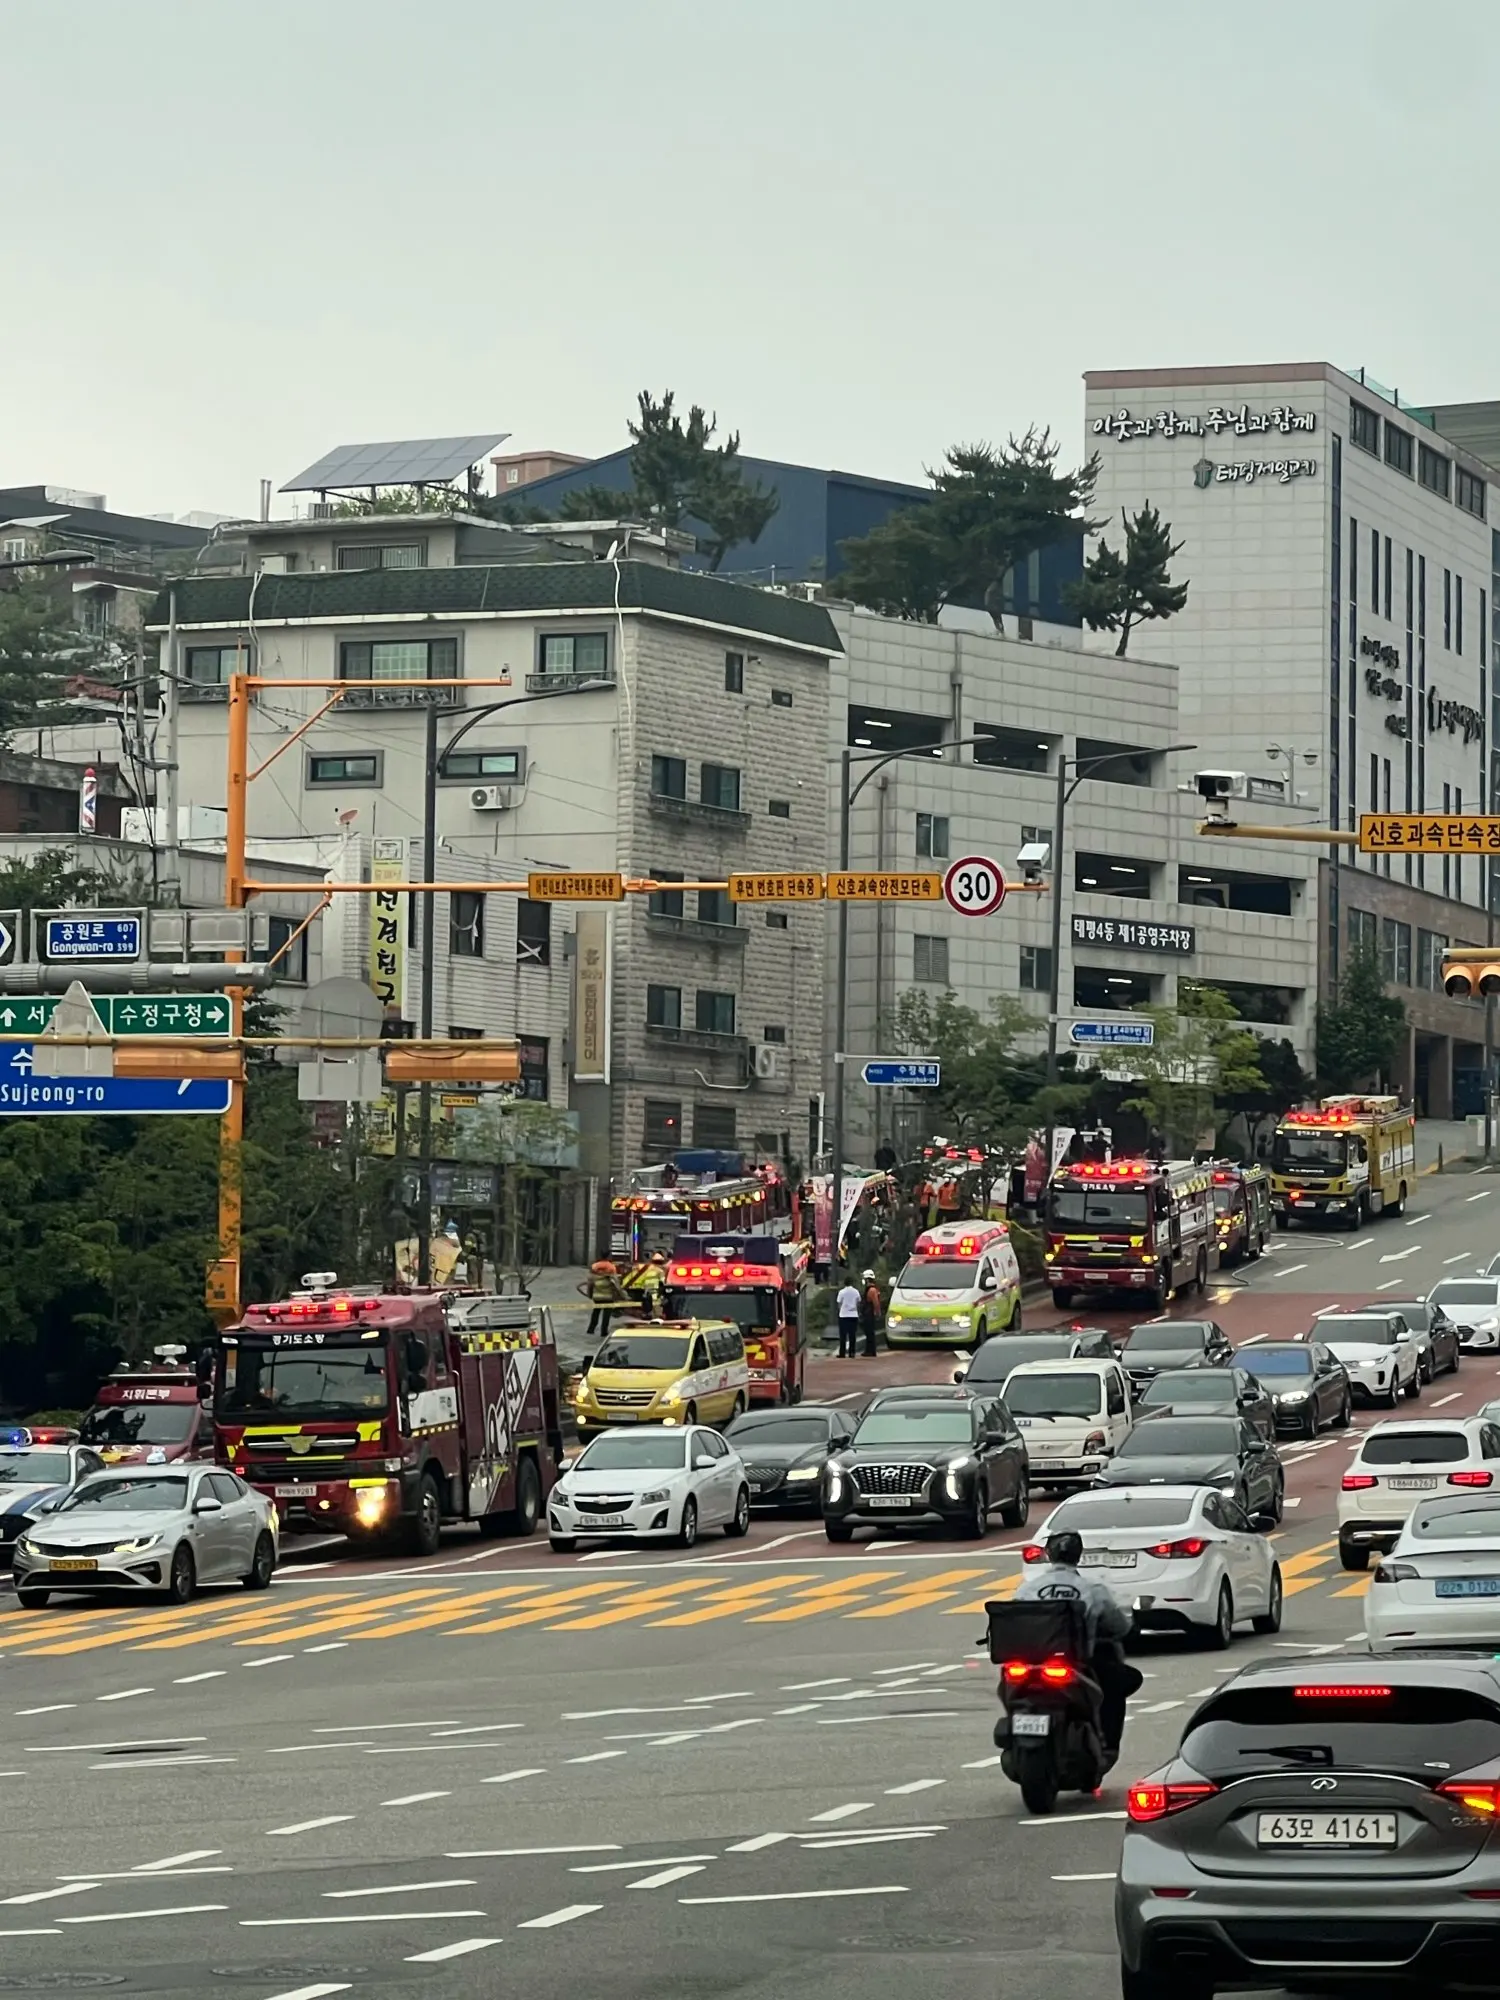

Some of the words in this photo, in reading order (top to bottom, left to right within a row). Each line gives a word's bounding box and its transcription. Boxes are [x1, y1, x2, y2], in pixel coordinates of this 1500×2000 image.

[1093, 408, 1154, 441] 이웃과
[1205, 404, 1269, 436] 주님과
[1270, 406, 1315, 437] 함께
[736, 879, 753, 897] 후면
[757, 880, 785, 897] 번호판
[788, 878, 814, 896] 단속중
[957, 871, 991, 902] 30
[61, 924, 105, 940] 공원로
[117, 924, 133, 932] 607
[1074, 919, 1115, 941] 태평4동
[1118, 923, 1190, 949] 제1공영주차장
[52, 941, 113, 954] Gongwon-ro
[117, 943, 133, 951] 399
[120, 1004, 201, 1027] 수정구청
[1, 1083, 105, 1105] Sujeong-ro
[272, 1334, 325, 1345] 경기도소방
[122, 1388, 171, 1400] 지휘본부
[1040, 1583, 1079, 1599] Arai
[1270, 1817, 1314, 1839] 63모
[1325, 1817, 1381, 1839] 4161
